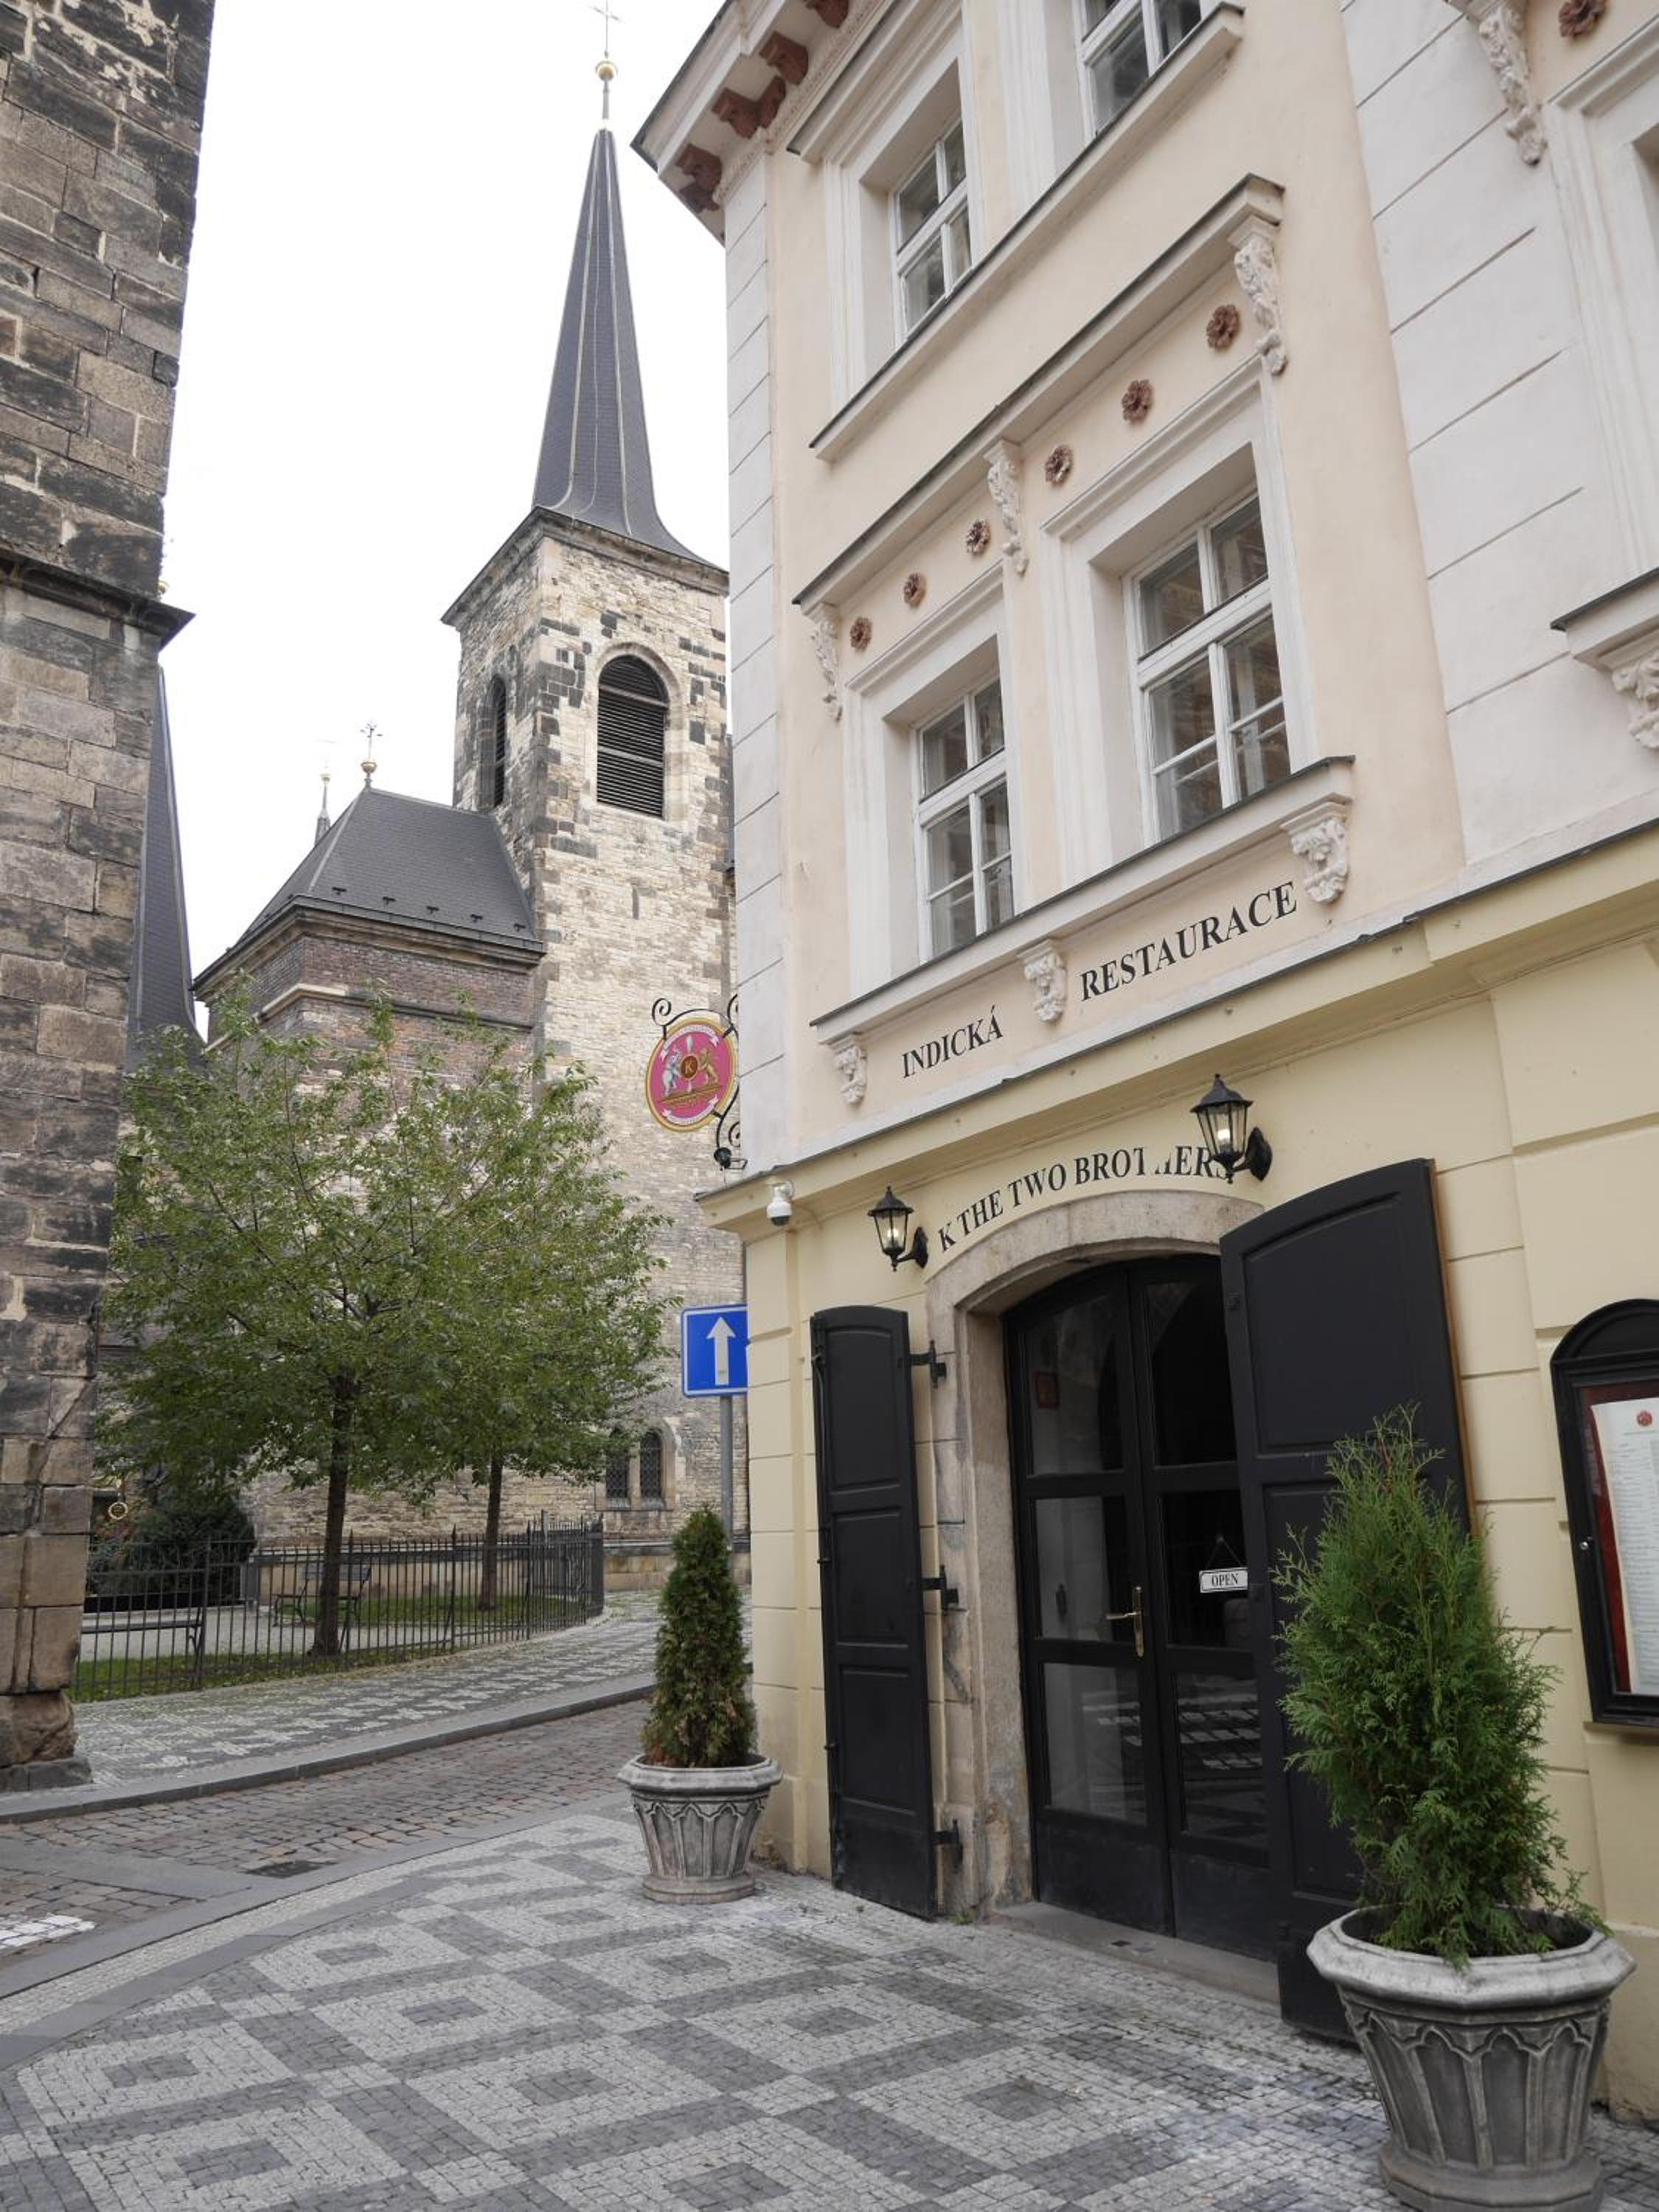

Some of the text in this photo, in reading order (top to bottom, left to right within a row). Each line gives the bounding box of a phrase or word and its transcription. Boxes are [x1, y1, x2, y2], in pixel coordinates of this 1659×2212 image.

[902, 880, 1298, 1079] INDICKÁ RESTAURACE
[937, 1220, 956, 1253] K
[956, 1189, 1004, 1237] THE
[1008, 1163, 1067, 1208] TWO
[1211, 1573, 1239, 1587] OPEN
